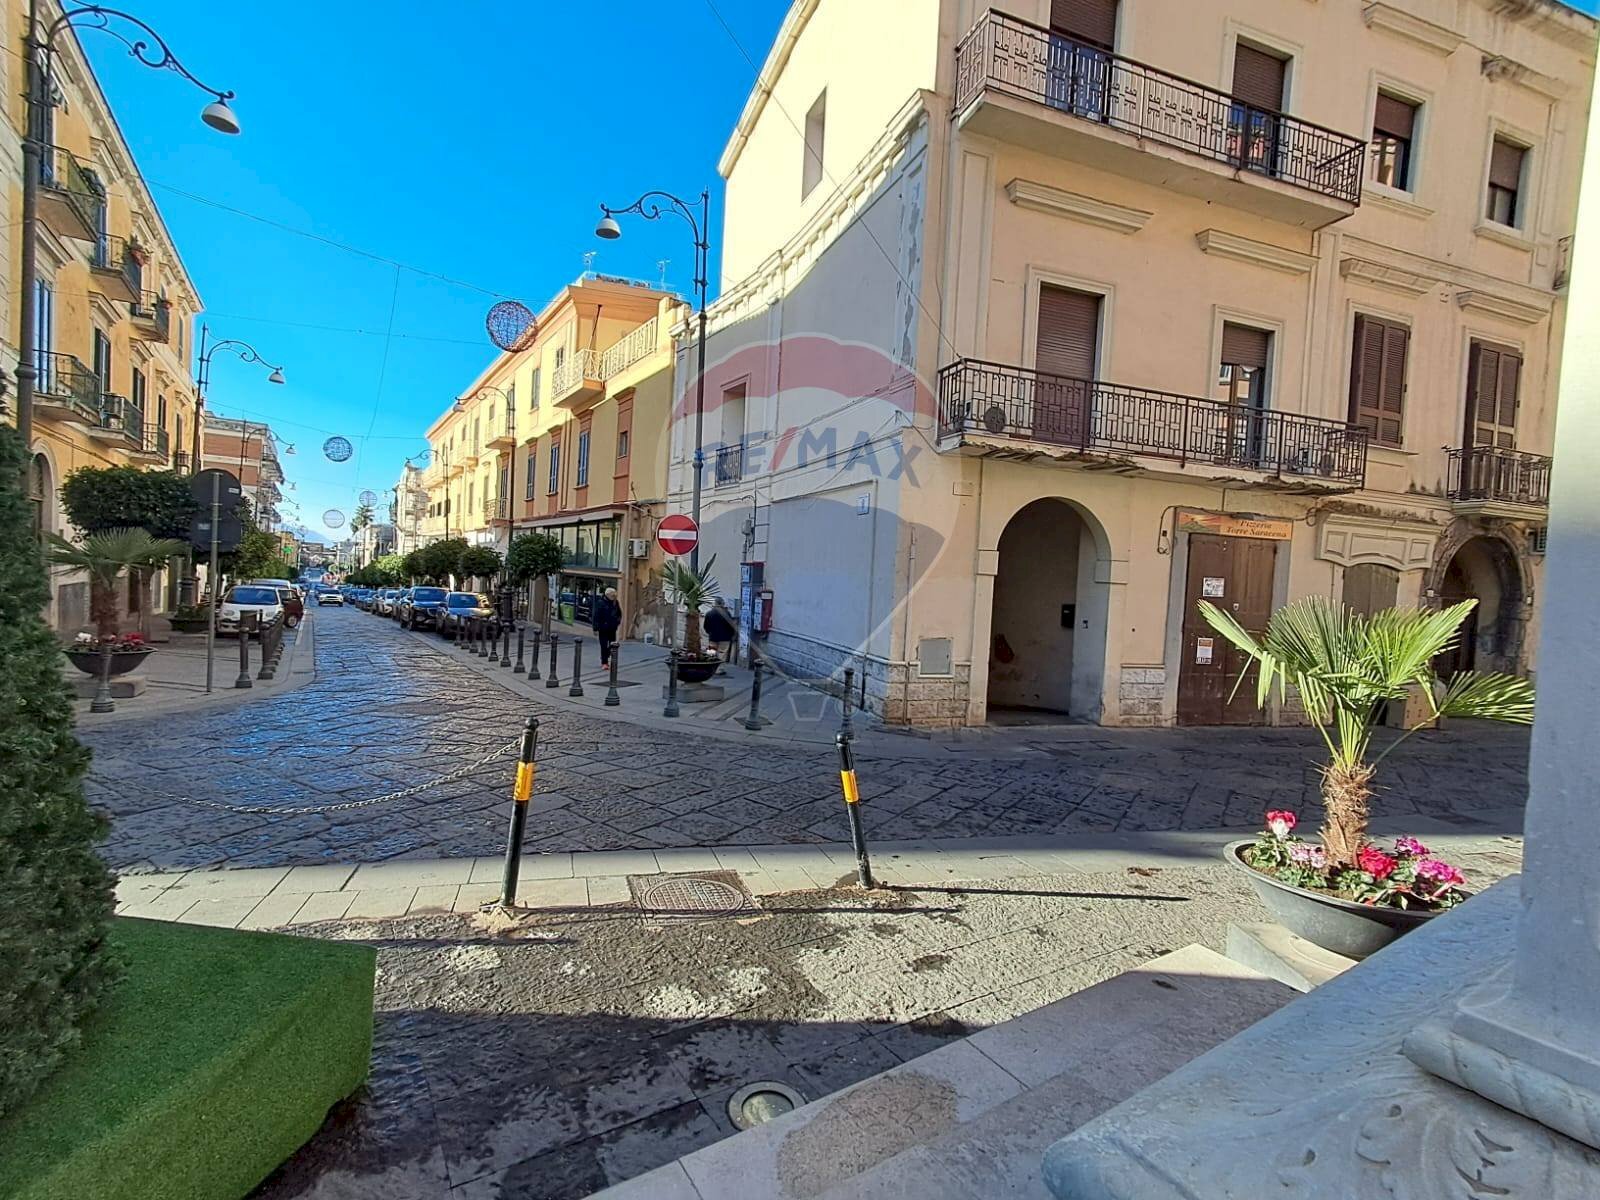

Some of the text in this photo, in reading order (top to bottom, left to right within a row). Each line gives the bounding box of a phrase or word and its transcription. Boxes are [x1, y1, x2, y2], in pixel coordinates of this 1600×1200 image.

[1240, 520, 1272, 529] Pizzeria
[1227, 527, 1287, 537] Torre Saracena
